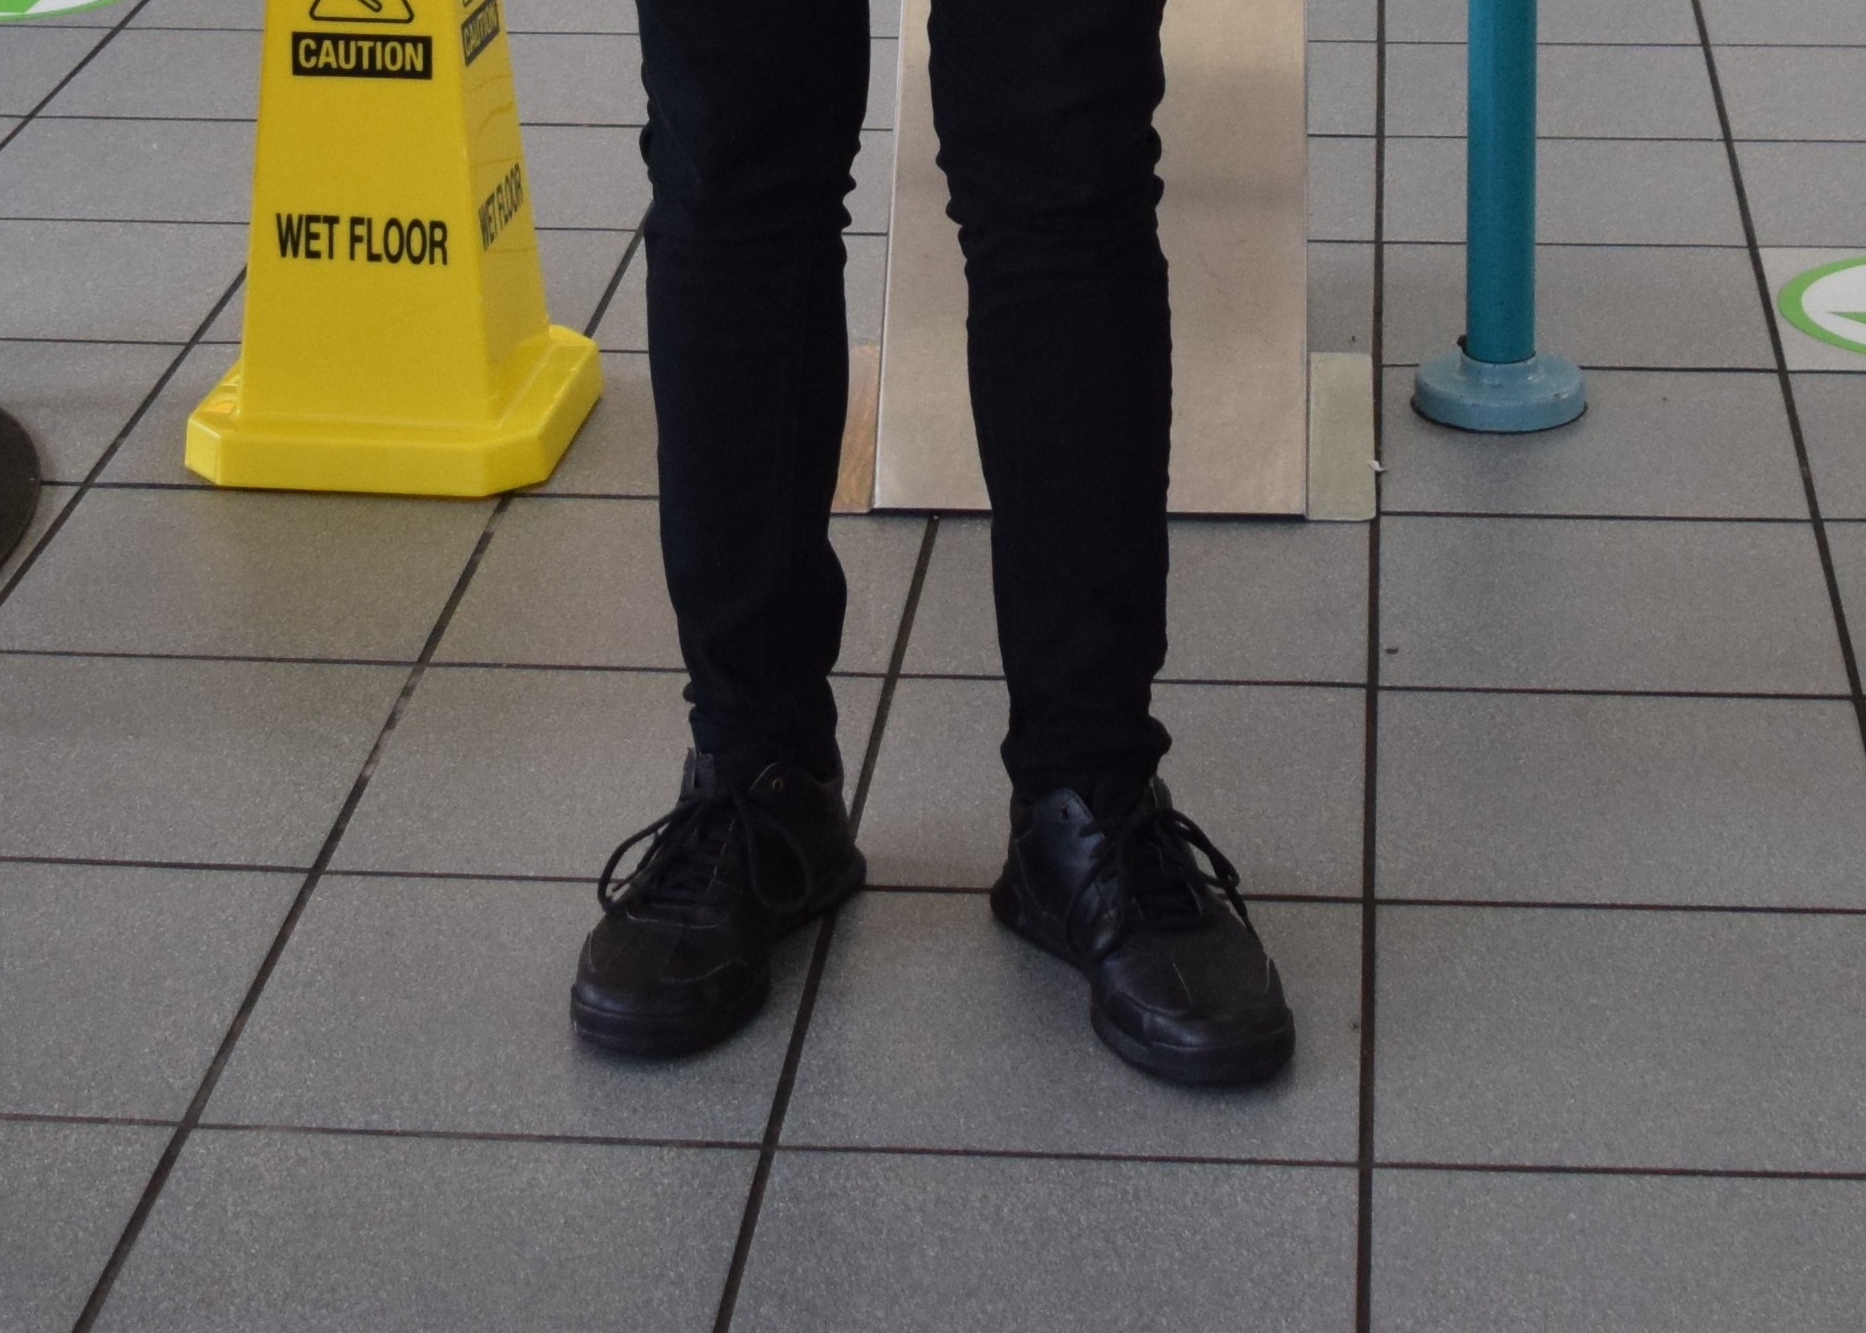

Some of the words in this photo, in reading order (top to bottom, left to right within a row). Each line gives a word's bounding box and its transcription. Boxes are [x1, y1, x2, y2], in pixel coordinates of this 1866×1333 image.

[298, 38, 424, 72] CAUTION
[275, 212, 340, 261] WET
[349, 216, 448, 266] FLOOR
